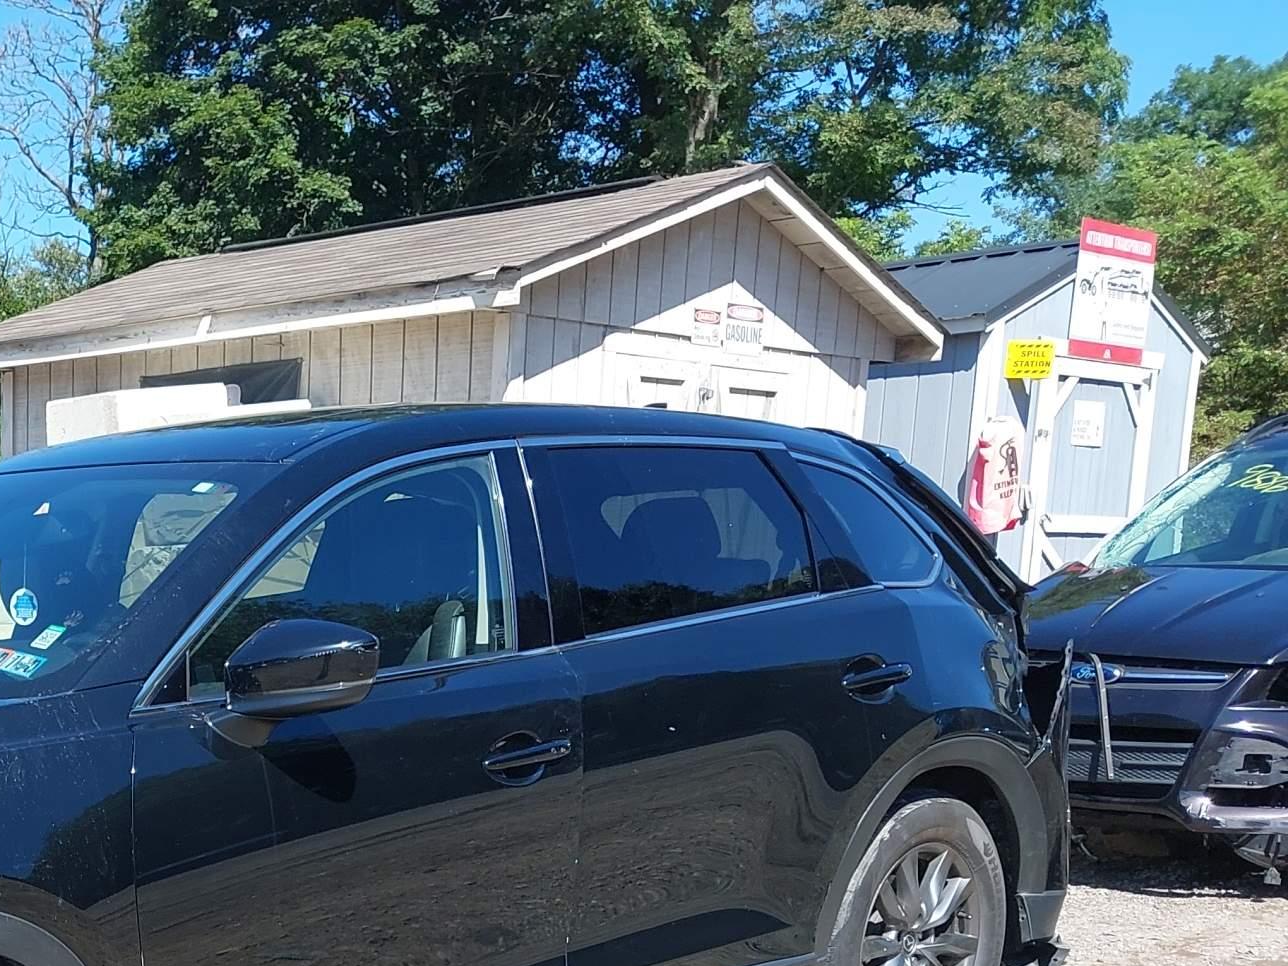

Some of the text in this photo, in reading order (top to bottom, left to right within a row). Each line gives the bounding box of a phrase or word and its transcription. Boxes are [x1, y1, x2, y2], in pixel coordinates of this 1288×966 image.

[726, 323, 763, 345] GASOLINE
[1020, 350, 1046, 358] SPILL
[1012, 360, 1051, 368] STATION
